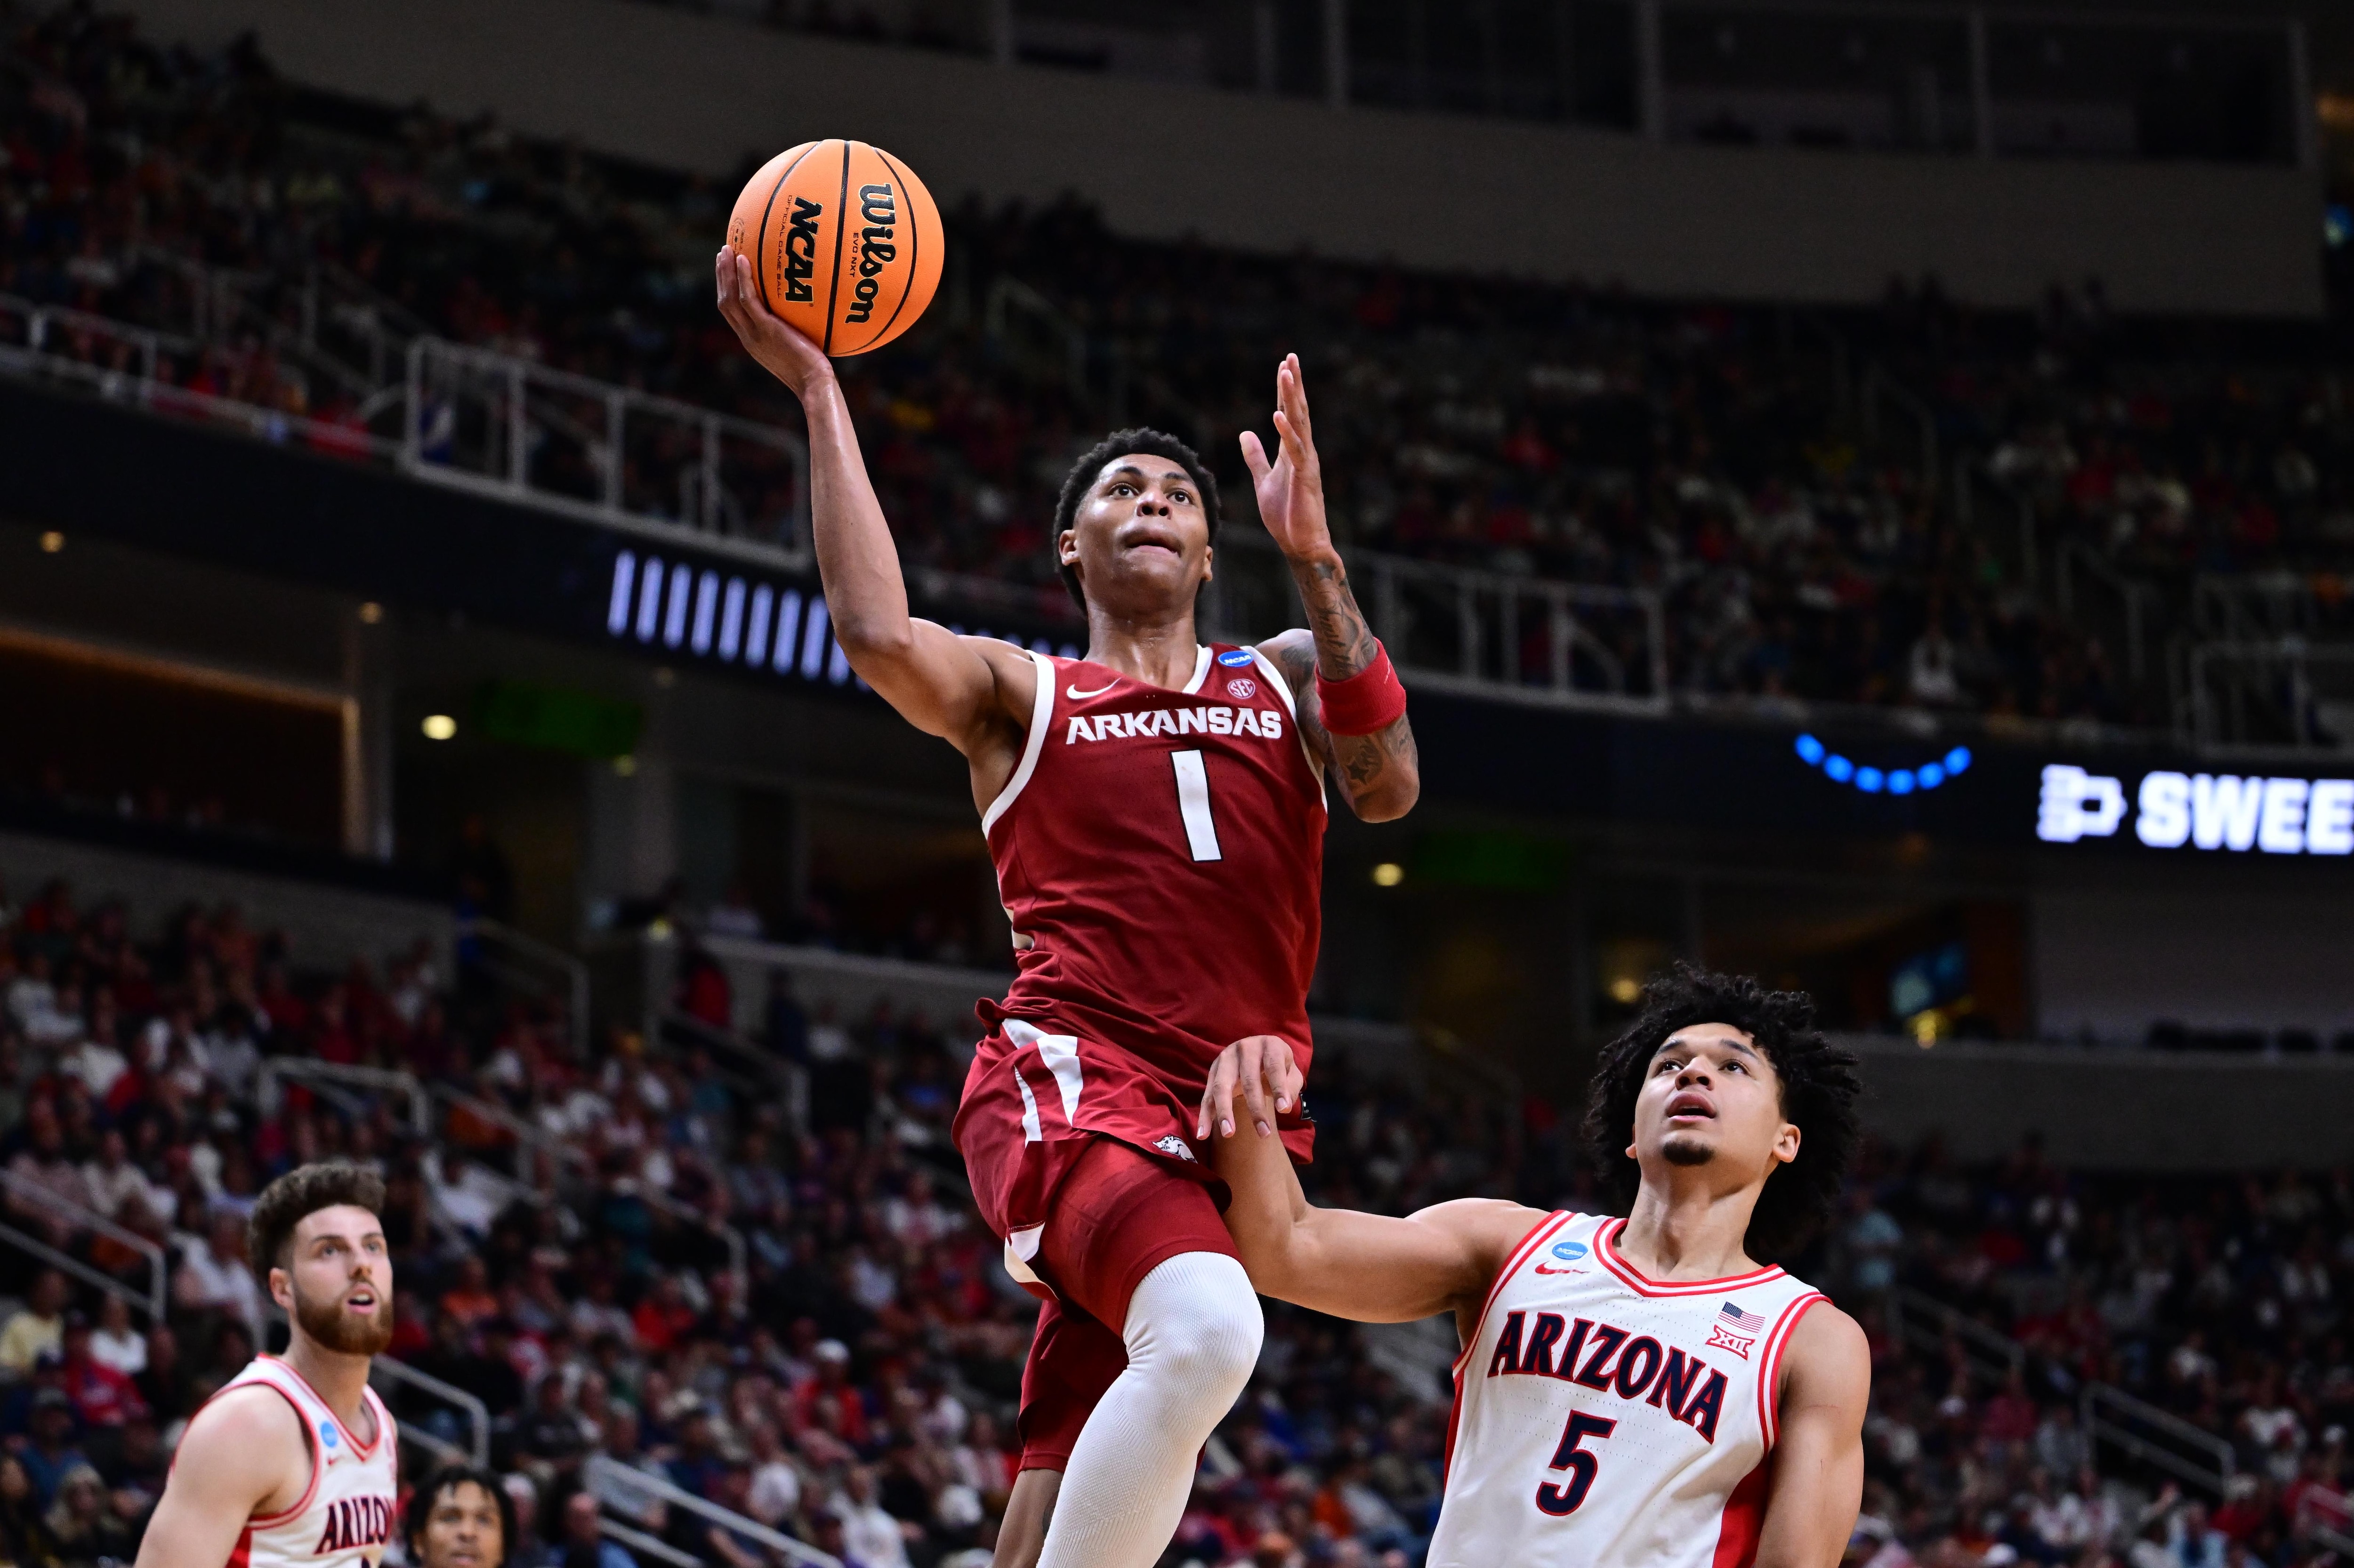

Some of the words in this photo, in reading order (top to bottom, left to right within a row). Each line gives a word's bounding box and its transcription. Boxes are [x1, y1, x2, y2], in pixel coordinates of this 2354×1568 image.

[780, 194, 792, 238] OFFICIAL
[784, 196, 823, 303] NCAA
[845, 183, 896, 324] Wilson
[1225, 654, 1252, 664] NCAA
[1229, 679, 1253, 697] SEC
[1065, 707, 1282, 745] ARKANSAS
[1170, 749, 1223, 862] 1
[2135, 770, 2354, 855] SWEE
[1487, 1310, 1728, 1445] ARIZONA
[1535, 1409, 1618, 1516] 5
[313, 1494, 395, 1555] ARIZO
